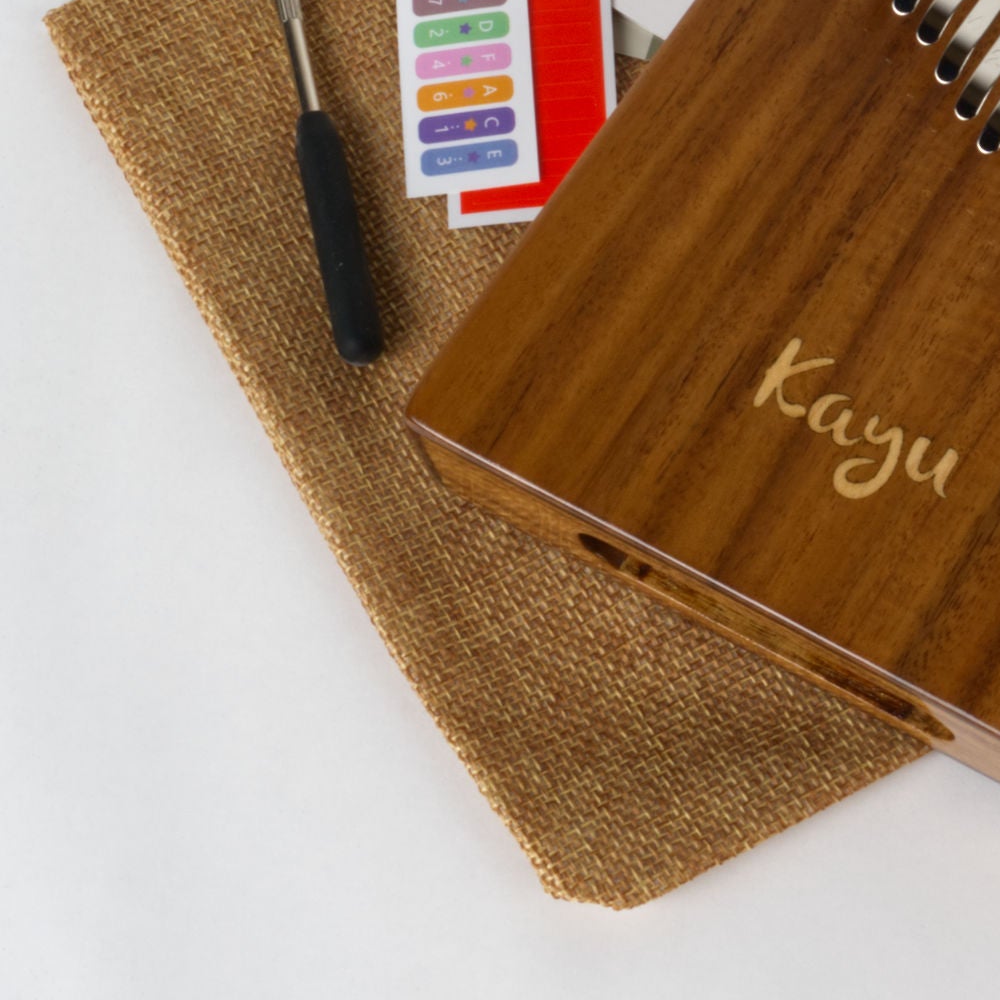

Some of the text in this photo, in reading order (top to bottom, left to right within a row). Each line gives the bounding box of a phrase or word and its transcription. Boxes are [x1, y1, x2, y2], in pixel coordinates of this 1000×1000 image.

[478, 20, 494, 32] D
[480, 53, 496, 62] F
[482, 84, 497, 96] A
[484, 116, 500, 128] C
[486, 150, 502, 160] E
[753, 338, 959, 500] Kayu
